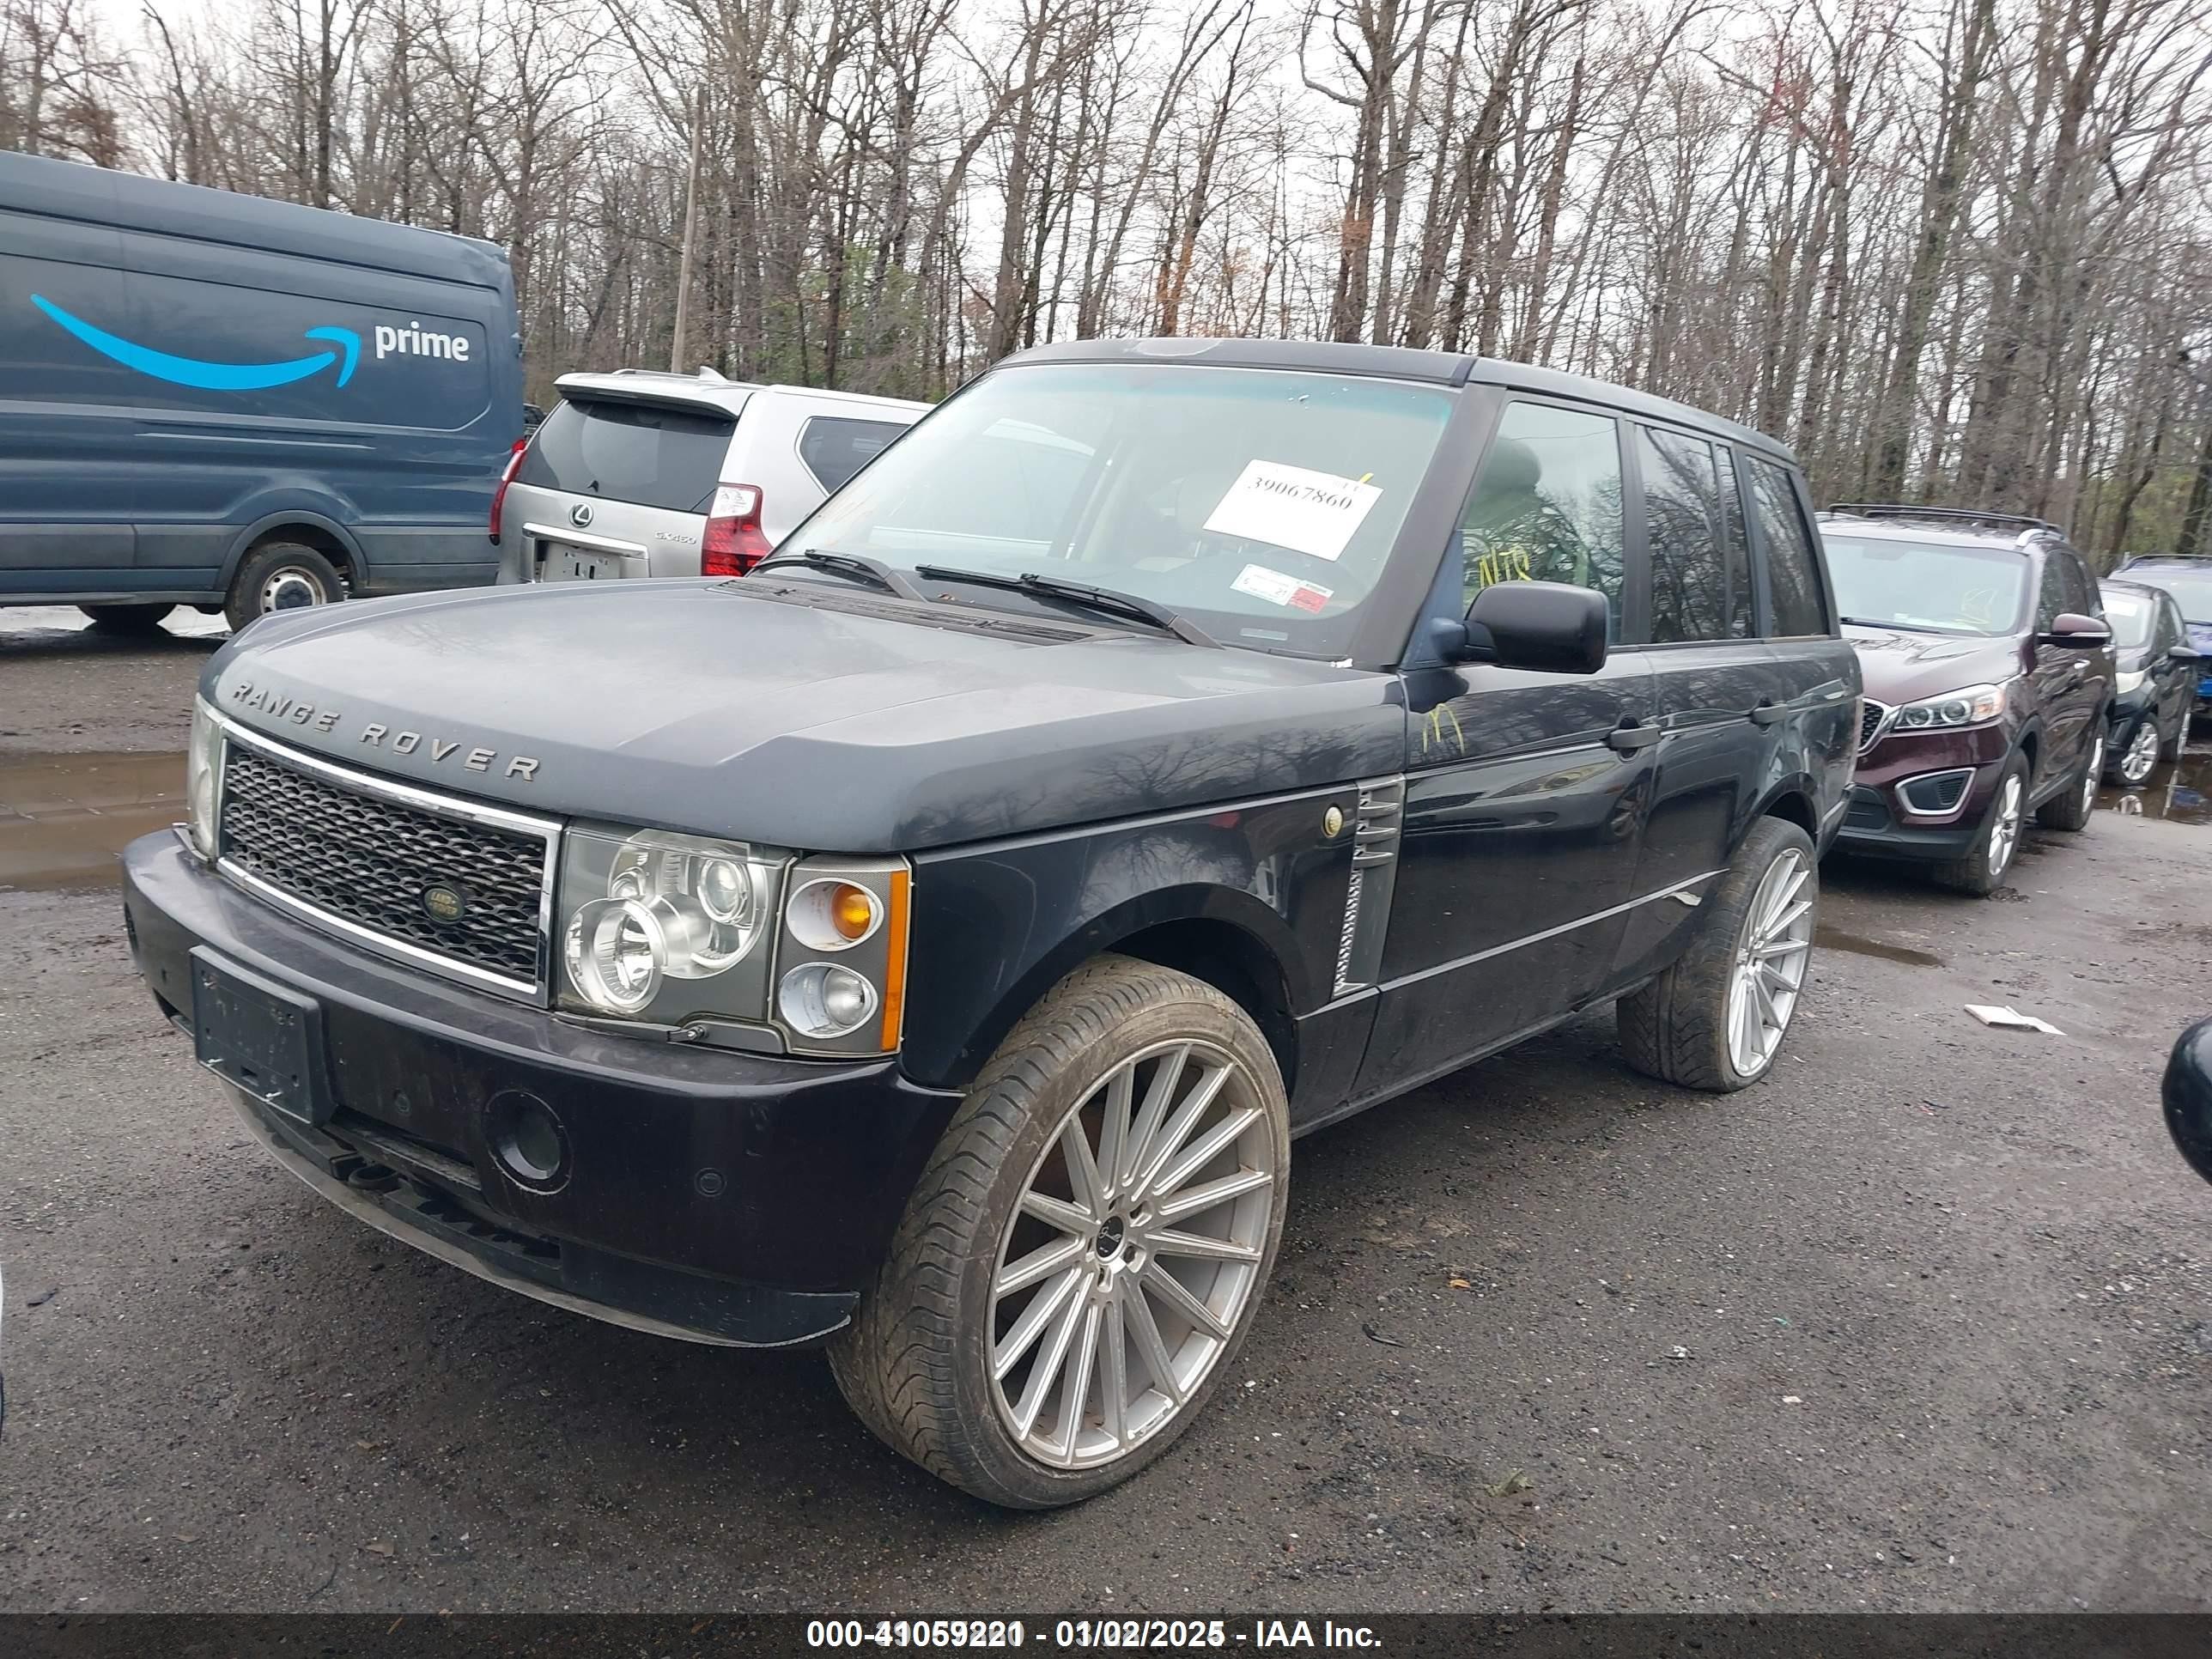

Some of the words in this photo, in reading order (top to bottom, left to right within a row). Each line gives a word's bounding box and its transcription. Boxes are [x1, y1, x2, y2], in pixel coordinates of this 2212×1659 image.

[375, 320, 470, 361] prime
[1255, 477, 1352, 510] 39067860
[232, 680, 341, 733] RANGE
[359, 722, 541, 782] ROVER
